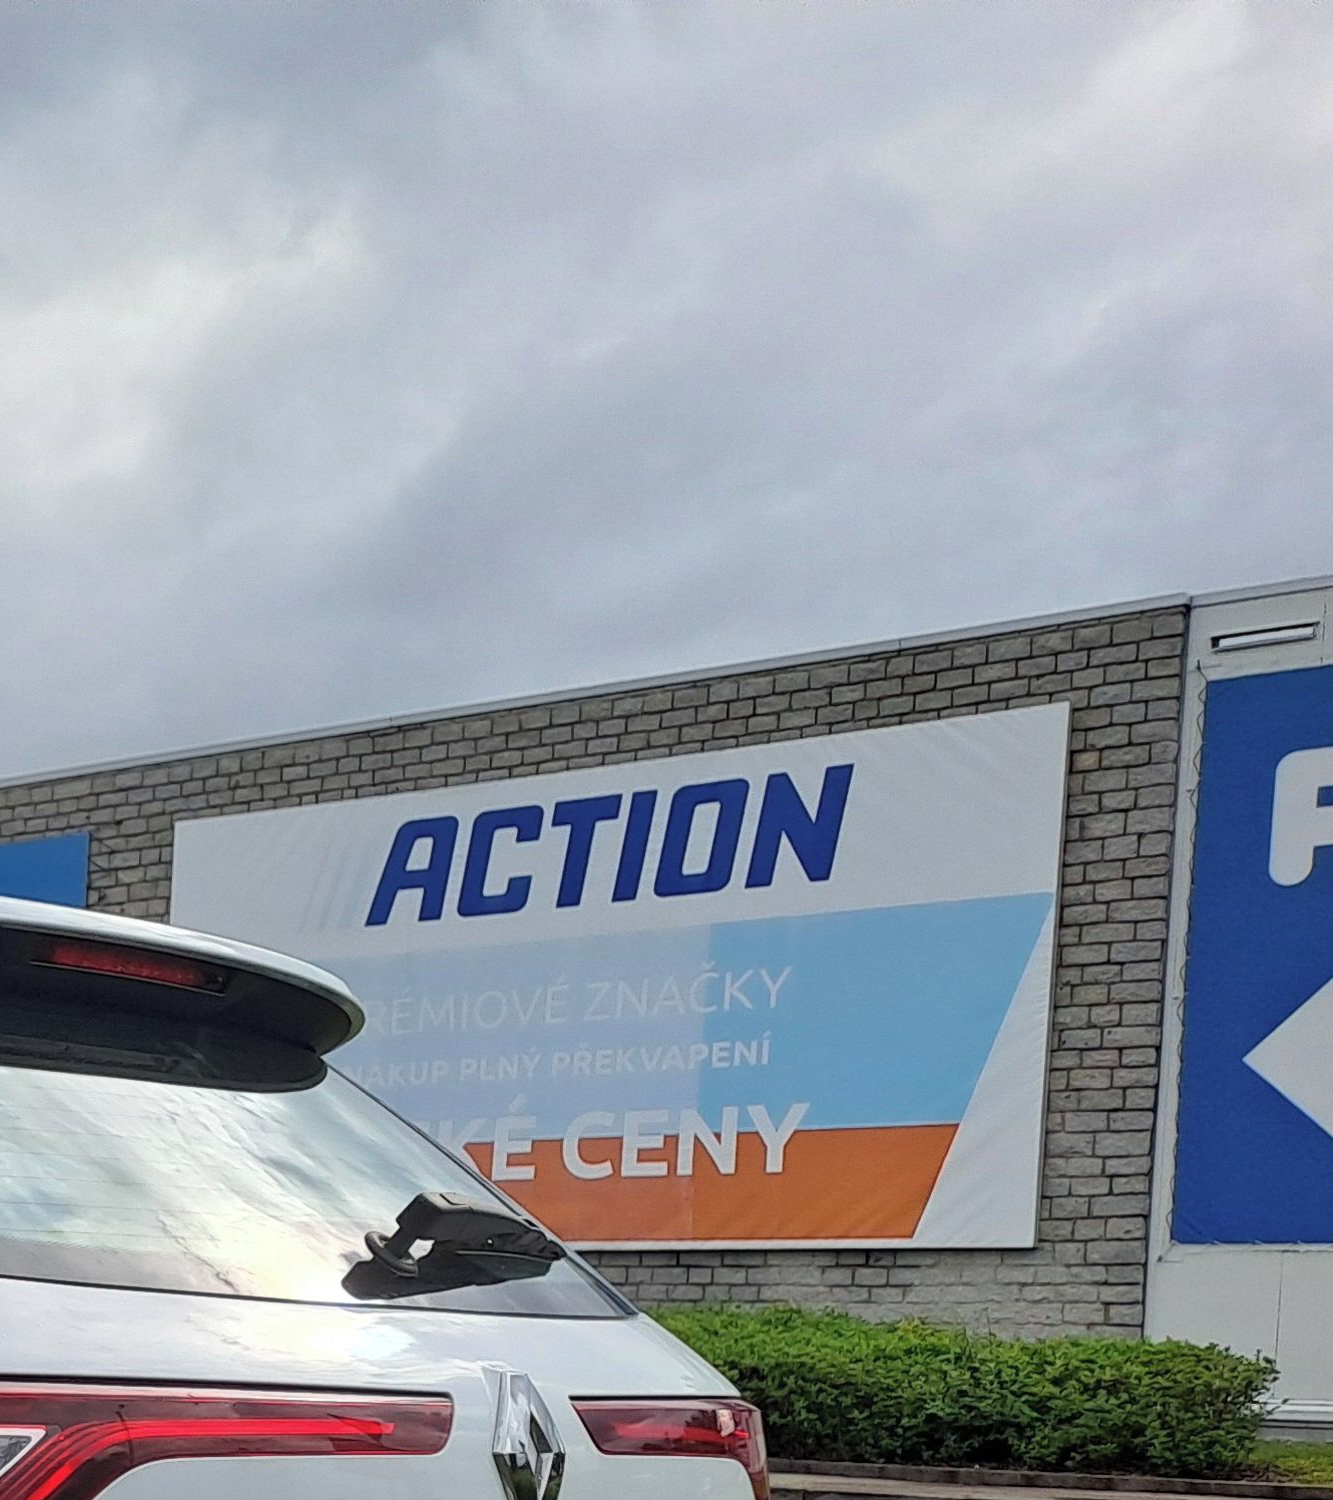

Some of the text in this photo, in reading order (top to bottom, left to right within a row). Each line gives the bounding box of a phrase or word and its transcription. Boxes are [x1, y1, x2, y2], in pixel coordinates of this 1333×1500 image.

[364, 763, 855, 927] ACTION
[364, 961, 792, 1037] RÉMIOVÉ ZNAČKY
[458, 1047, 540, 1083] PLNÝ
[551, 1030, 772, 1077] PŘEKVAPENÍ
[561, 1102, 811, 1181] CENY
